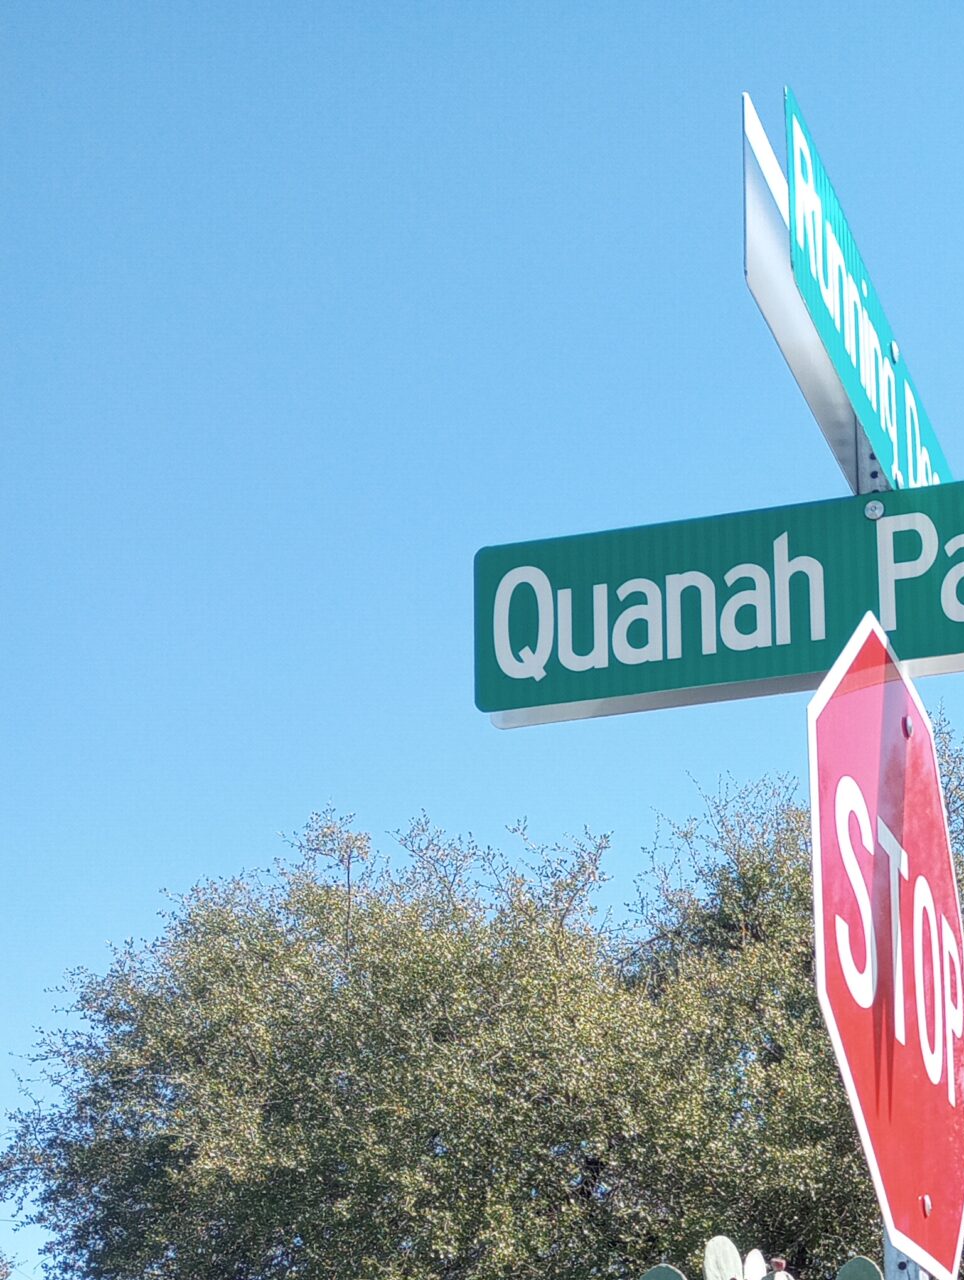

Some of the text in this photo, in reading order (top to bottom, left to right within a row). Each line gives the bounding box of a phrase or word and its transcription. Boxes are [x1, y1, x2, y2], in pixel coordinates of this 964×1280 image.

[791, 112, 899, 484] Running
[493, 531, 826, 682] Quanah
[835, 775, 964, 1107] STOP
